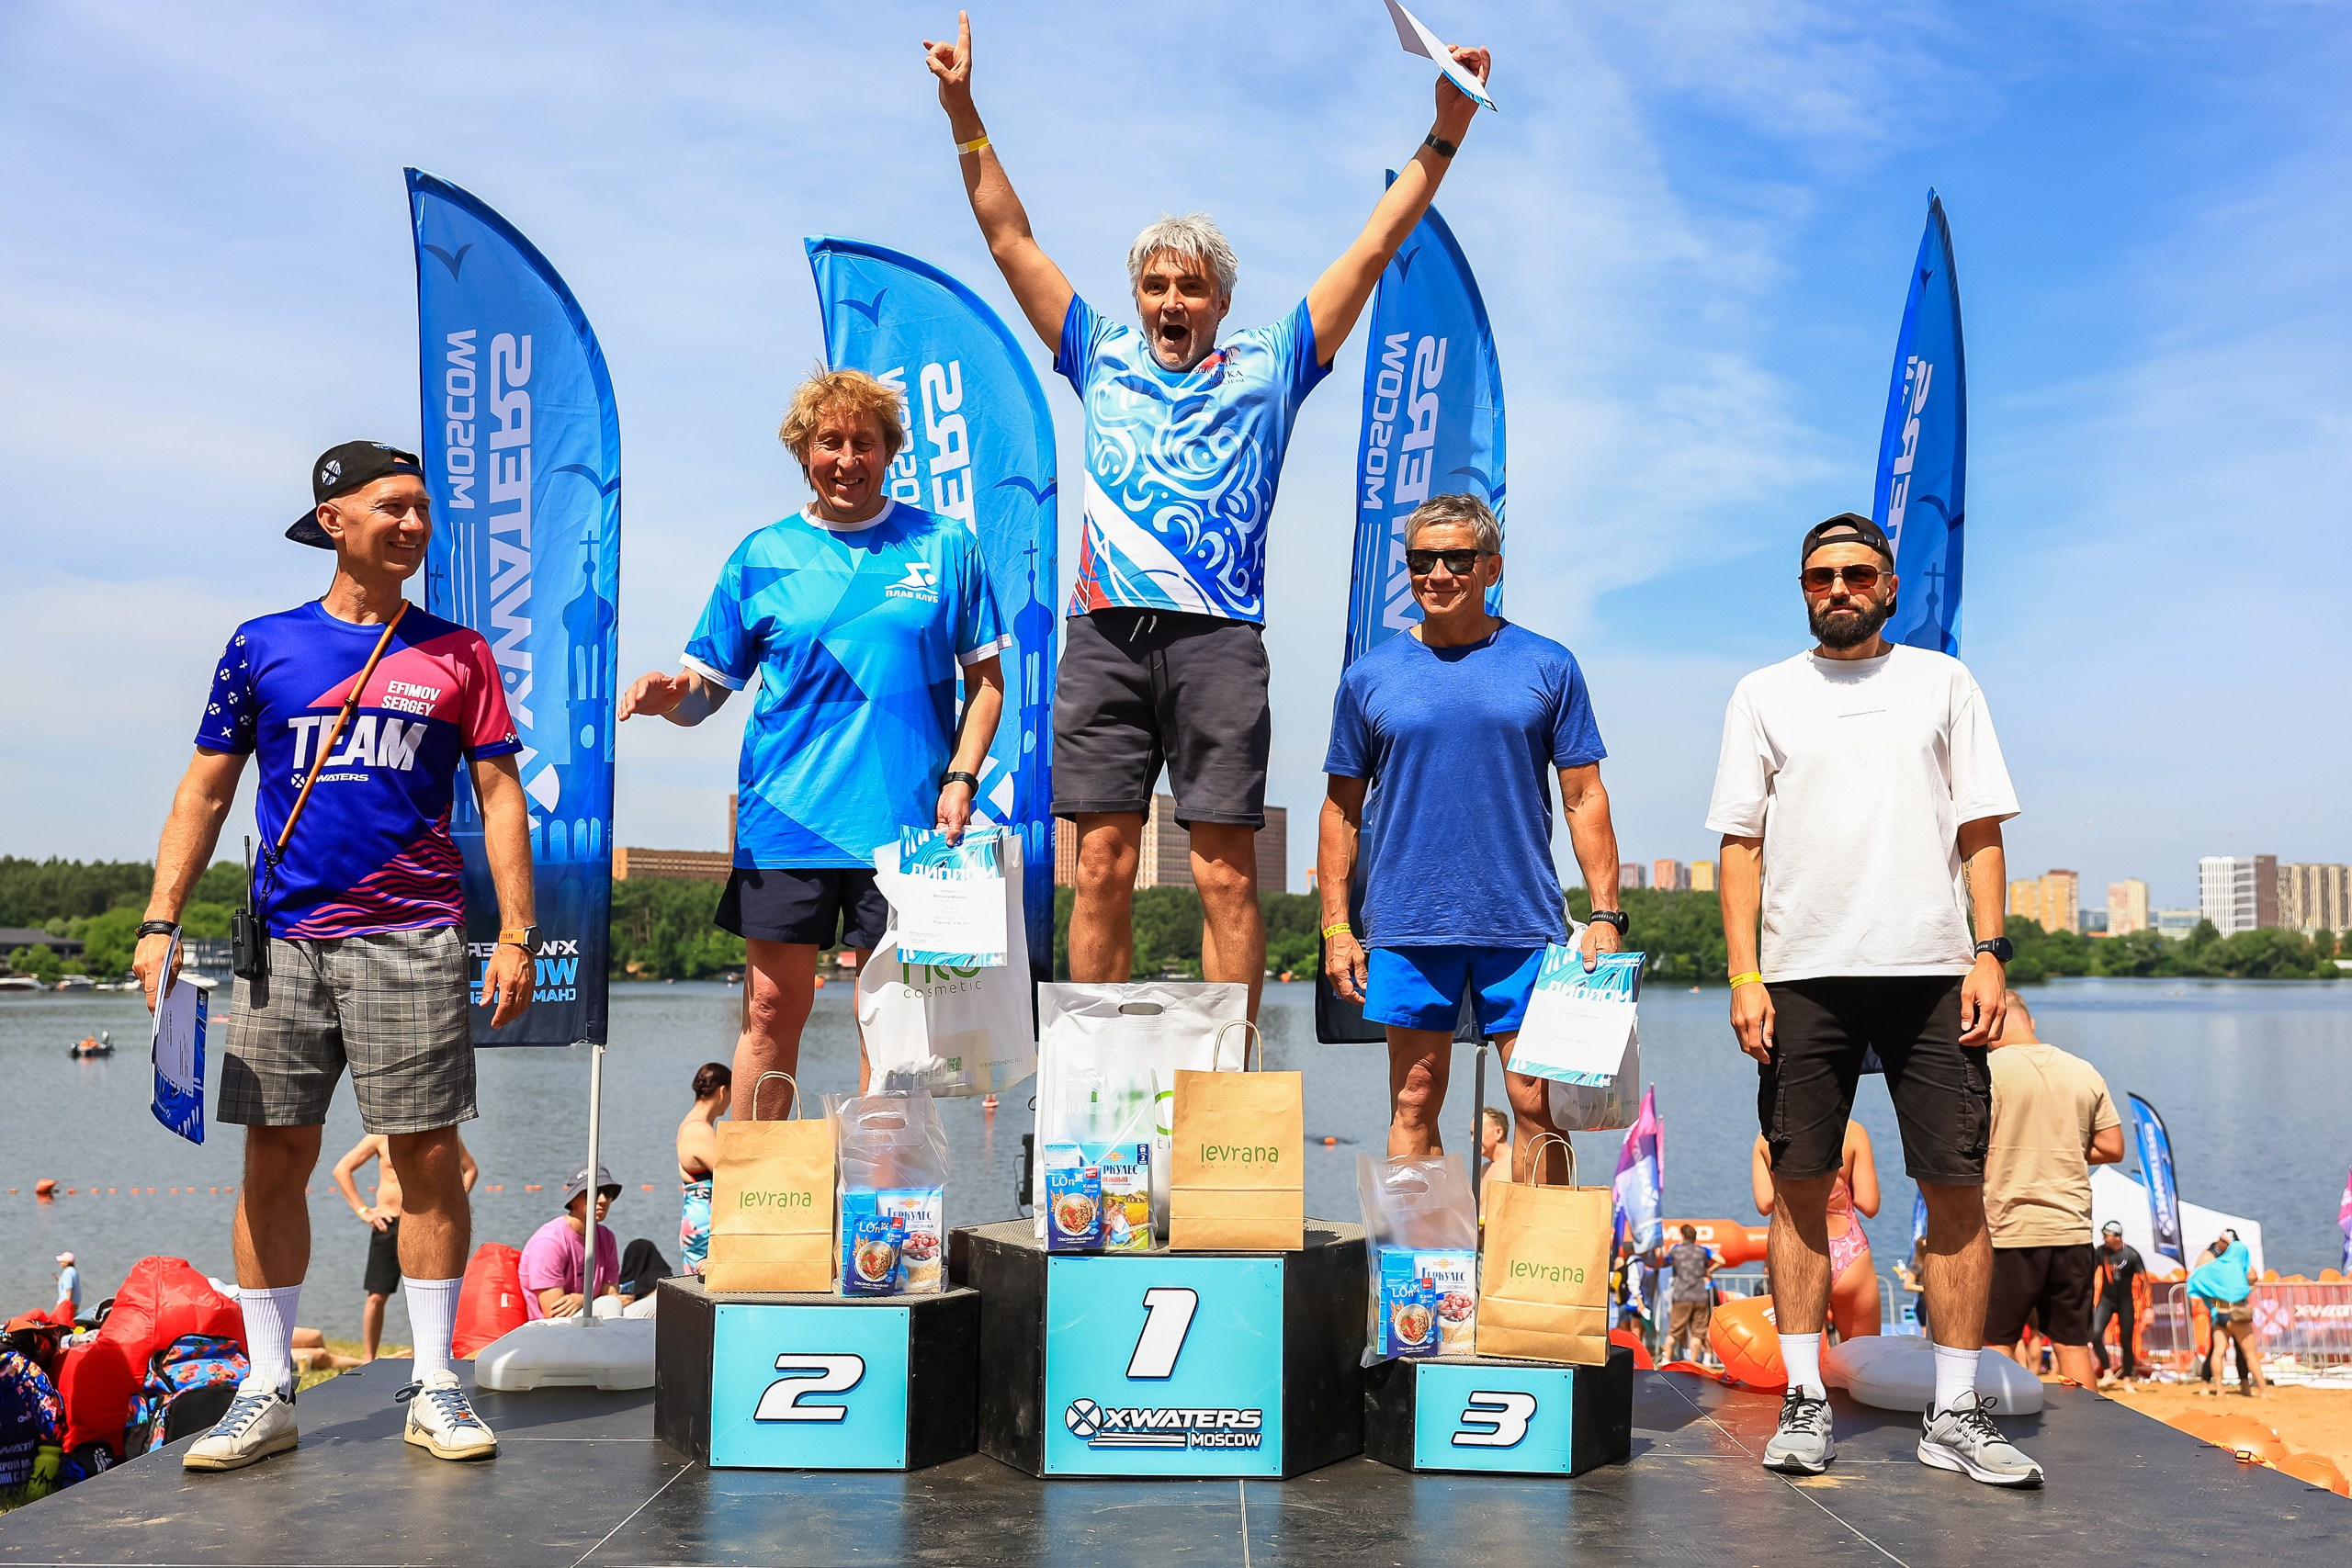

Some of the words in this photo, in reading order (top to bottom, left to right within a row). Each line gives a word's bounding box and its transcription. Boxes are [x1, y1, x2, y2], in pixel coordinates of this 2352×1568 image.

[885, 590, 913, 598] ПЛАВ
[915, 592, 939, 604] КЛУБ
[387, 680, 441, 702] EFIMOV
[380, 695, 435, 717] SERGEY
[288, 715, 428, 772] TEAM
[903, 979, 982, 998] cosmetic
[1201, 1144, 1279, 1163] levrana
[1102, 1164, 1138, 1175] РКУЛЕС
[740, 1190, 812, 1209] levrana
[1510, 1259, 1585, 1283] levrana
[1125, 1287, 1200, 1382] 1
[753, 1353, 866, 1425] 2
[1451, 1390, 1537, 1450] 3
[1190, 1432, 1262, 1449] MOSCOW
